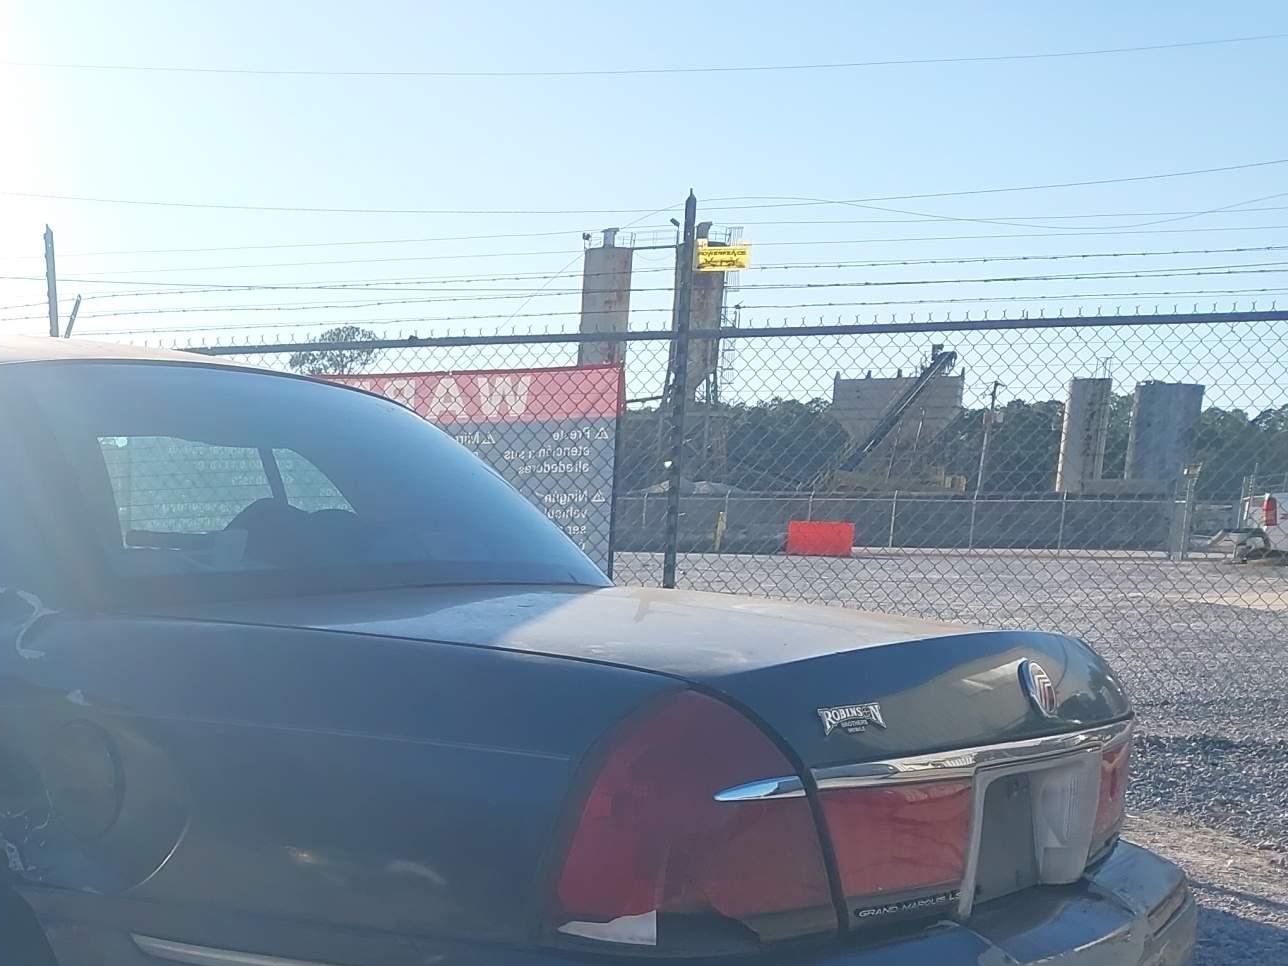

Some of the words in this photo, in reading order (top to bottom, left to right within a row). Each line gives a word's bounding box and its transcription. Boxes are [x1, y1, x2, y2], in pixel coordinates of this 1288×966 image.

[821, 703, 885, 733] ROBINSON
[858, 905, 898, 918] GRAND
[902, 895, 946, 911] MARQUIS
